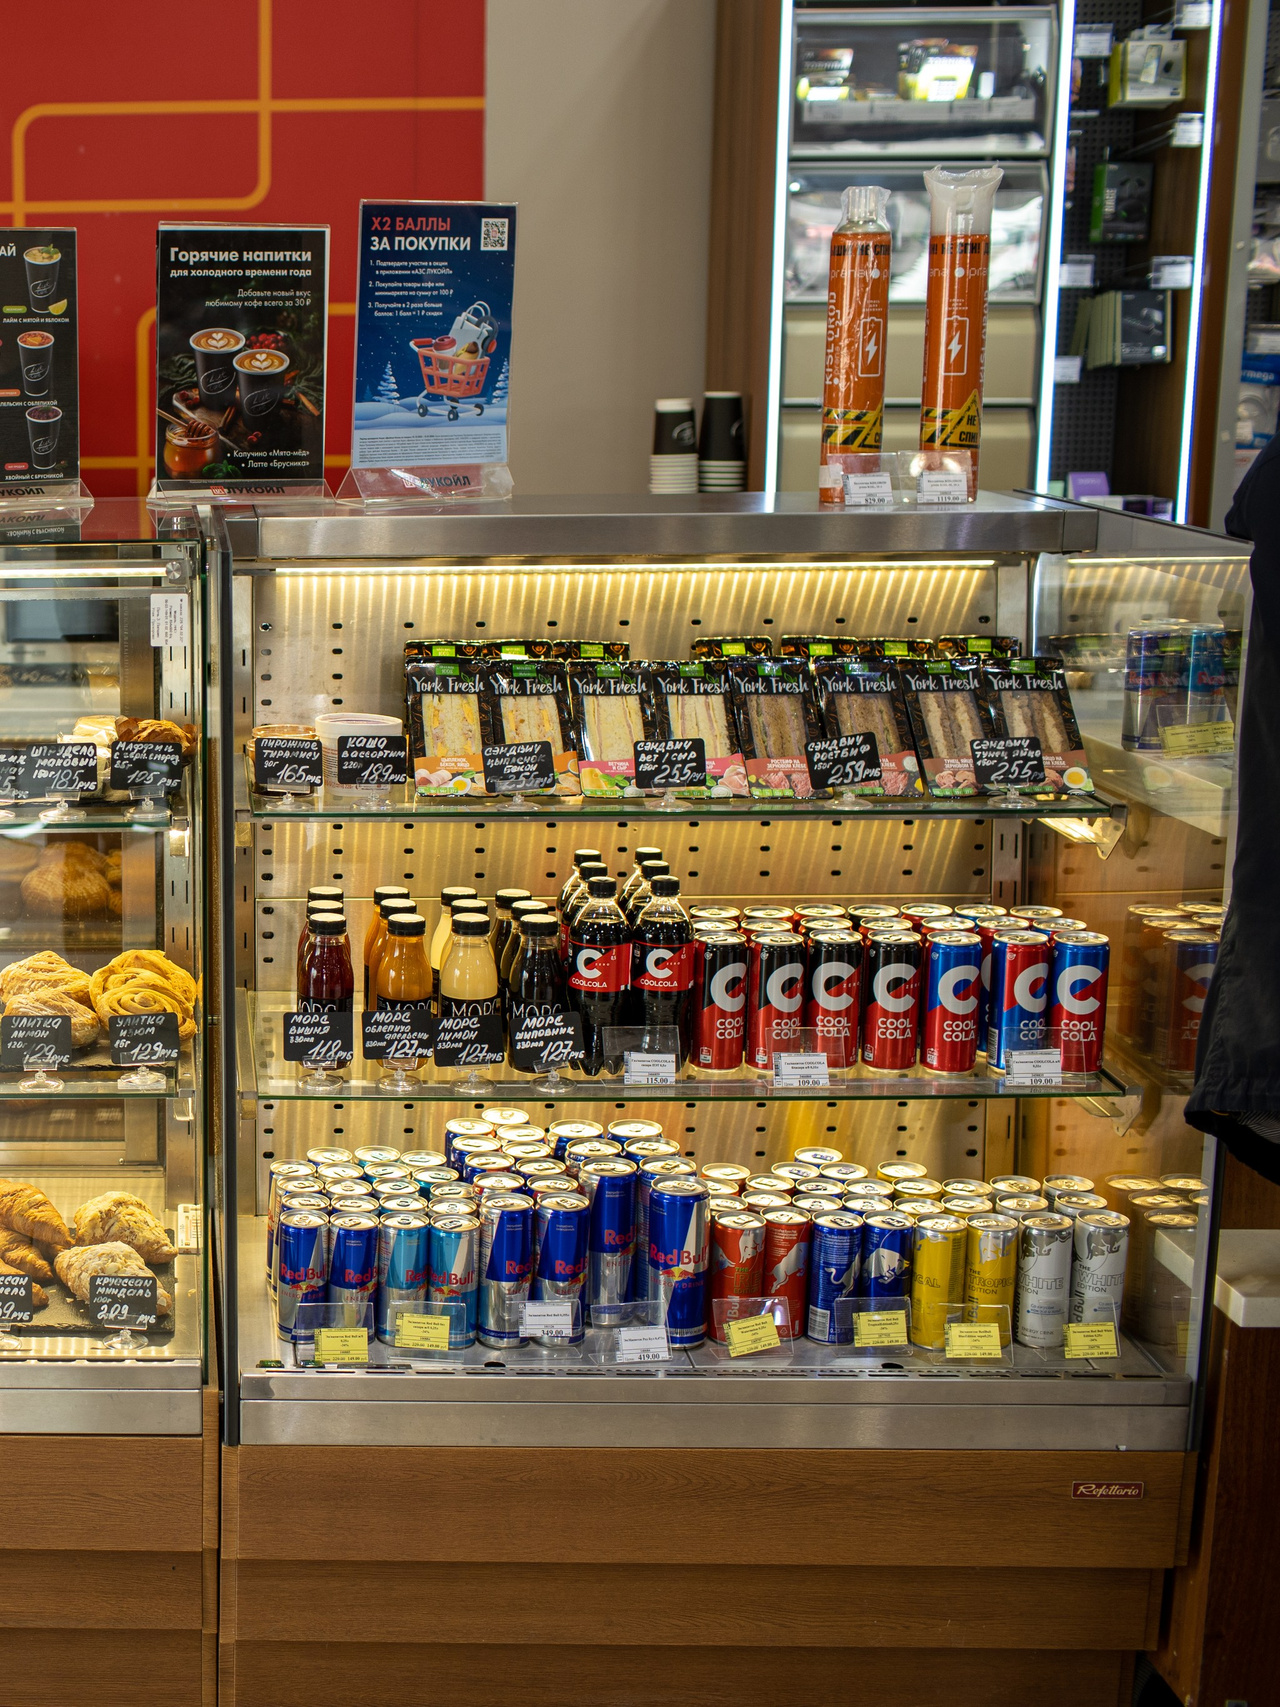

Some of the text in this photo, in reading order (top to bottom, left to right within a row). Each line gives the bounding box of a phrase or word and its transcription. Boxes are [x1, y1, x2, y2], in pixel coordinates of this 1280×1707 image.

[396, 218, 451, 230] БАЛЛЫ
[370, 237, 471, 250] ЗА ПОКУПКИ
[170, 248, 312, 265] Горячие напитки
[170, 269, 312, 278] для холодного времени года
[238, 289, 271, 298] Добавьте
[205, 300, 242, 308] любимому
[244, 300, 262, 308] кофе
[967, 415, 976, 426] НЕ
[233, 450, 268, 458] Капучино
[270, 460, 310, 469] «Брусника»
[412, 677, 485, 694] York Fresh
[489, 677, 563, 695] York Fresh
[574, 676, 647, 694] York Fresh
[657, 676, 730, 695] York Fresh
[823, 676, 897, 692] York Fresh
[989, 674, 1064, 691] York Fresh
[572, 978, 608, 988] COOLCOLA
[640, 978, 678, 988] COOLCOLA
[816, 1016, 851, 1027] COOL
[878, 1018, 912, 1028] COOL
[1061, 1020, 1097, 1030] COOL
[816, 1027, 850, 1037] COLA
[878, 1028, 912, 1039] COLA
[1061, 1030, 1096, 1042] COLA
[650, 1244, 678, 1264] Red
[281, 1264, 304, 1280] Red
[1077, 1282, 1107, 1293] EDITION
[1077, 1484, 1139, 1497] Refettorio
